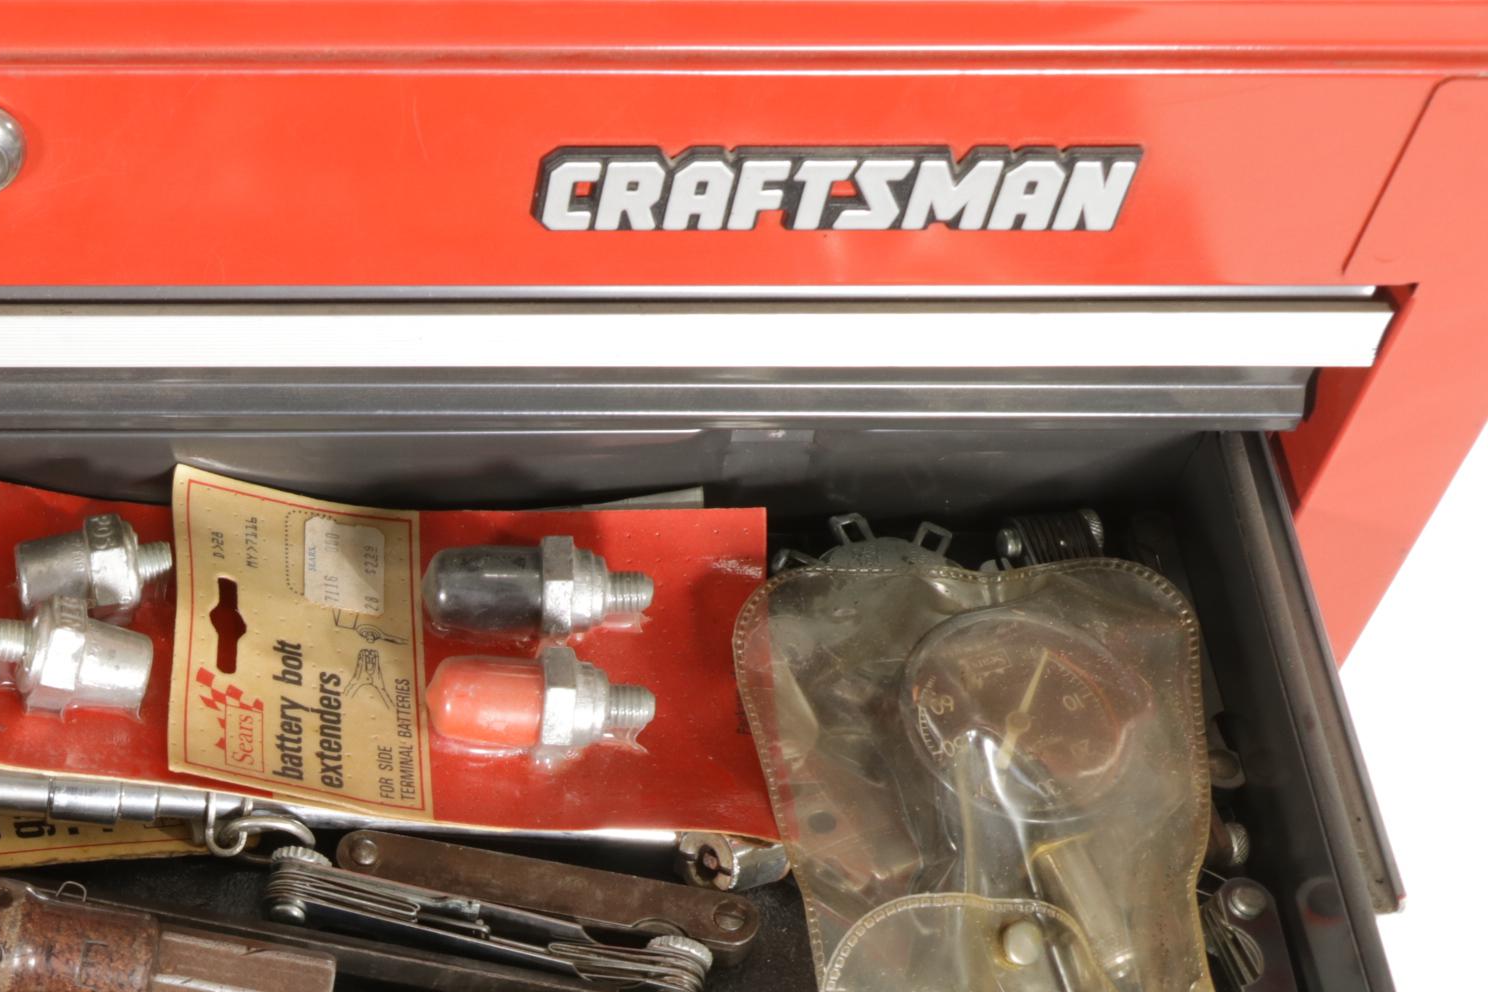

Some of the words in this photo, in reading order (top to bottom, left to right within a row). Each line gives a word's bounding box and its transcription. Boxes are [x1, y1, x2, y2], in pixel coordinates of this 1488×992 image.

[540, 158, 1138, 231] CRAFTSMAN
[272, 639, 304, 687] bolt
[309, 671, 345, 790] extenders
[394, 678, 414, 739] BATTERIES
[231, 713, 256, 766] Sears
[272, 696, 311, 781] battery
[377, 745, 394, 772] SIDE
[378, 776, 396, 800] FOR
[398, 744, 416, 801] TERMINAL
